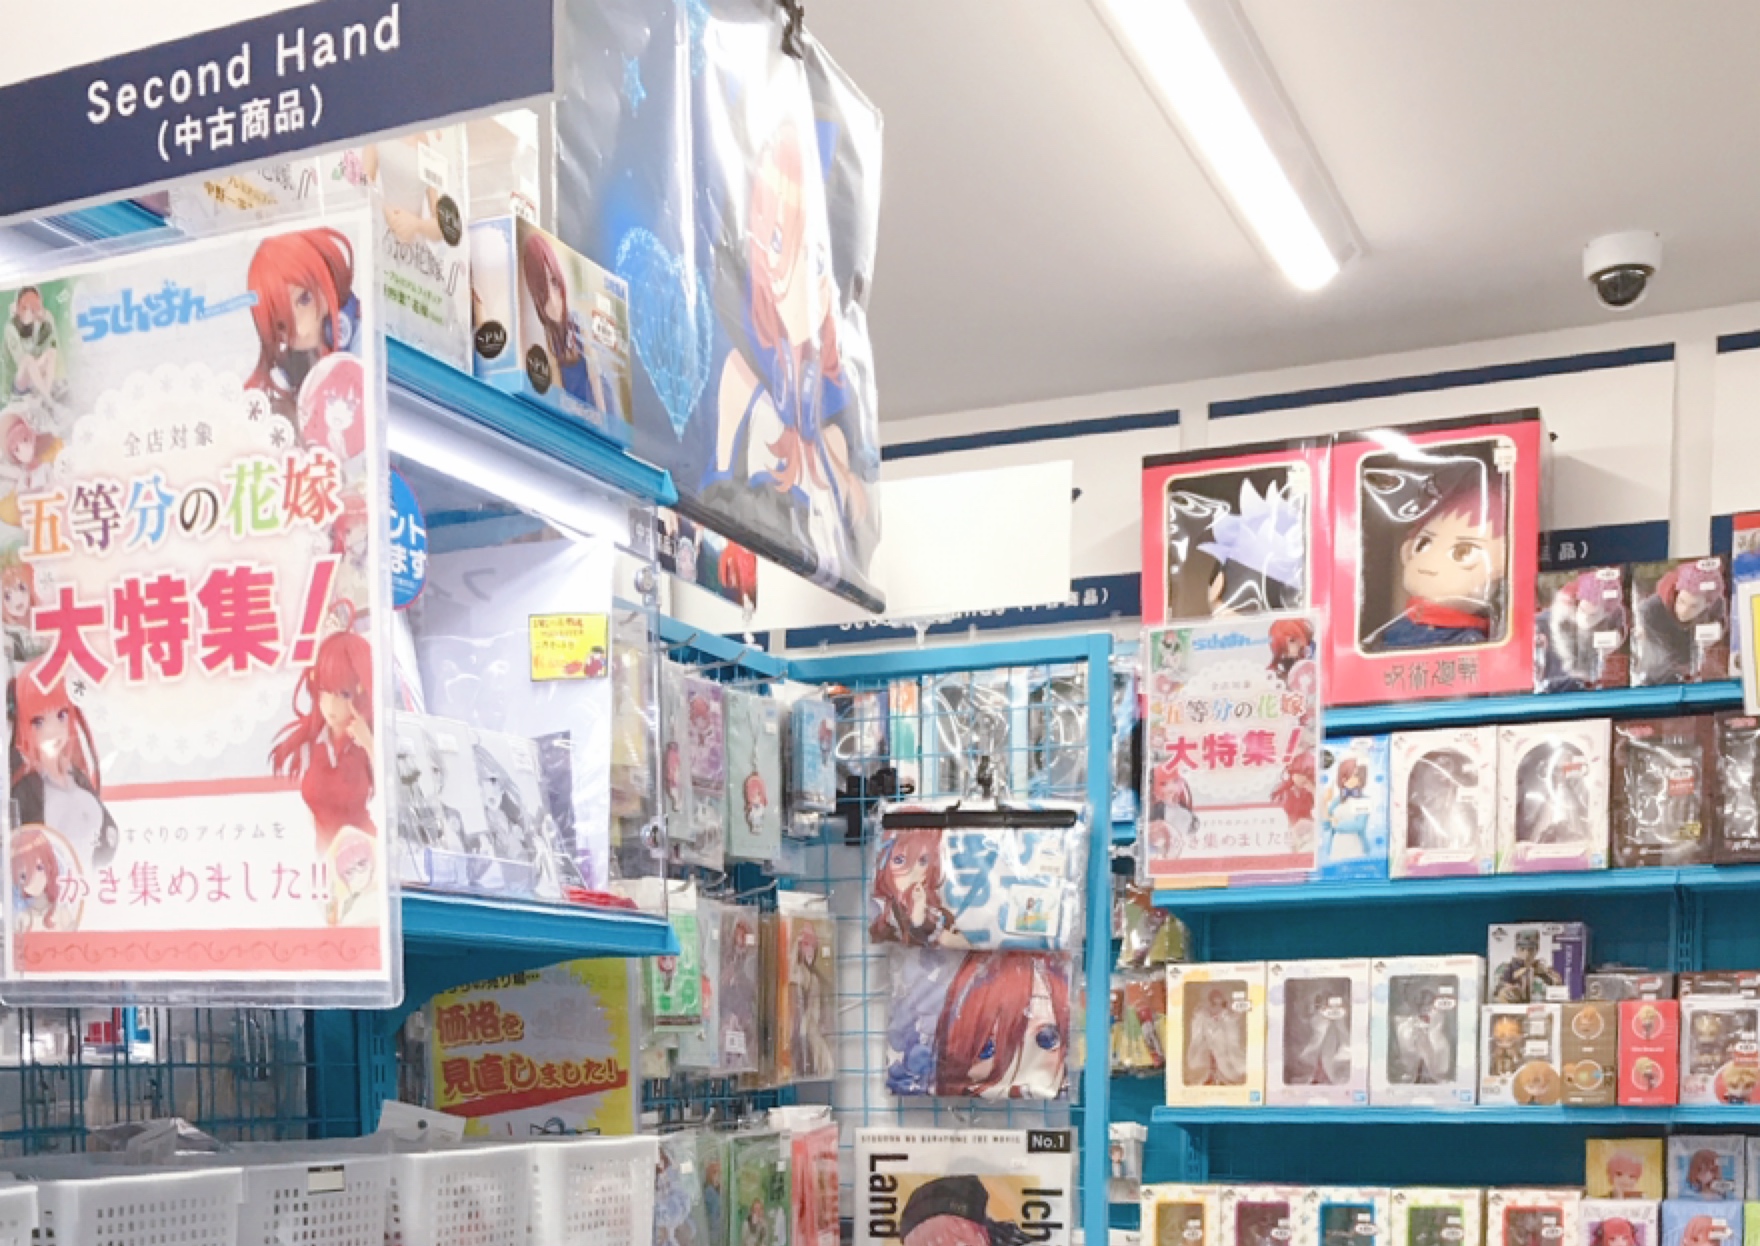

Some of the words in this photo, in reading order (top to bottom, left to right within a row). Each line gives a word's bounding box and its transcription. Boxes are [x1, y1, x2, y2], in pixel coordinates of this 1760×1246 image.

[87, 43, 251, 124] Second
[276, 3, 401, 79] Hand
[156, 84, 325, 162] (中古商品)
[123, 424, 214, 458] 全店対象
[22, 452, 340, 558] 五等分の花嫁
[34, 558, 337, 690] 大特集!
[1384, 657, 1480, 690] 呪術廻戦
[1165, 728, 1301, 772] 大特集!
[57, 859, 331, 906] かき集めました!!
[435, 1000, 524, 1047] 価格を
[440, 1053, 619, 1098] 見直しました!
[1031, 1132, 1066, 1149] No.1
[869, 1153, 908, 1239] Land
